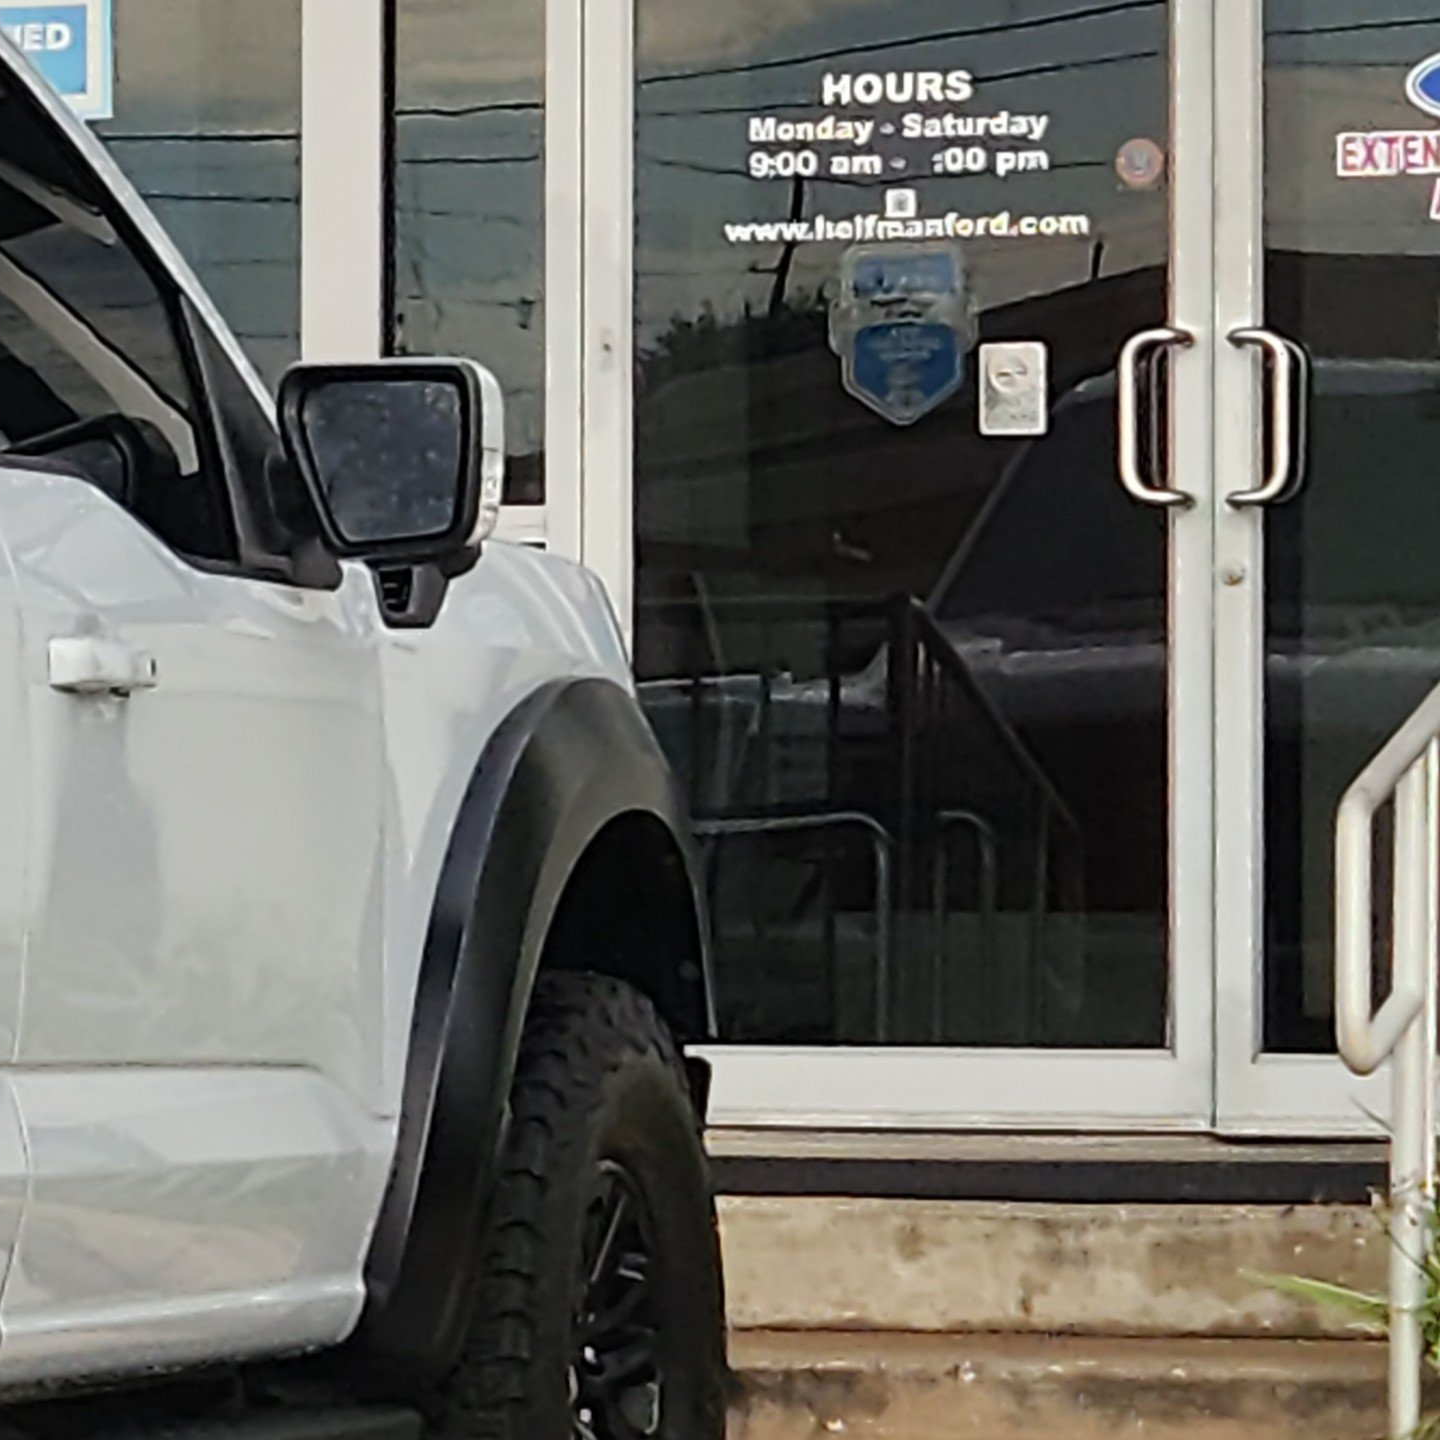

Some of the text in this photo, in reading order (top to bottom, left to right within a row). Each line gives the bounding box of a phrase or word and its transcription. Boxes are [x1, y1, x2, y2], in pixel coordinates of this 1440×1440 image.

[821, 69, 974, 107] HOURS
[748, 115, 875, 146] Monday
[900, 110, 1050, 140] Saturday
[748, 149, 818, 178] 9:00
[829, 153, 883, 175] am
[995, 148, 1050, 178] pm
[723, 210, 1091, 243] www.helfmanford.com
